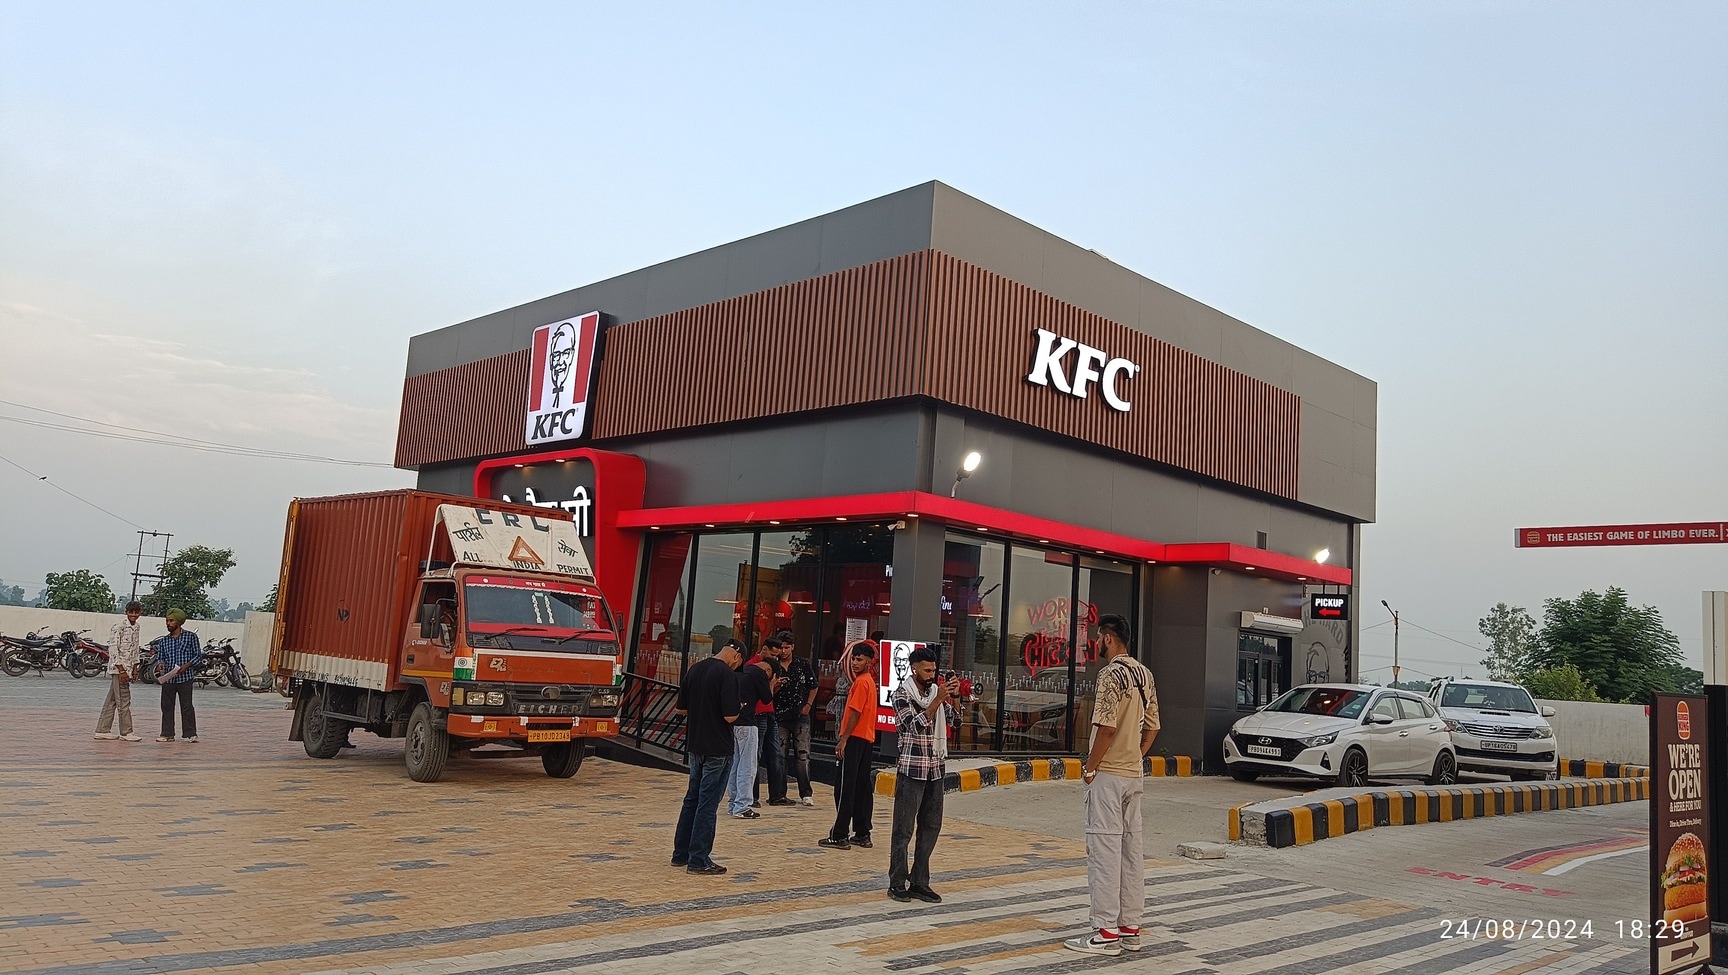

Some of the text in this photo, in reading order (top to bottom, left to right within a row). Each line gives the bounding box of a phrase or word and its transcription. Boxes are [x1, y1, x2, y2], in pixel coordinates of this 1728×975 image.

[1028, 327, 1135, 412] KFC
[531, 408, 576, 441] KFC
[1546, 533, 1564, 542] THE
[1567, 532, 1604, 541] EASIEST
[1606, 530, 1634, 540] GAME
[1637, 530, 1651, 539] OF
[1653, 529, 1685, 539] LIMBO
[1688, 528, 1719, 538] EVER.
[462, 550, 589, 576] ALL INDIA PERMIT
[1315, 598, 1344, 607] PICKUP
[877, 714, 887, 723] NO
[1667, 743, 1701, 769] WE'RE
[1668, 769, 1701, 800] OPEN
[1669, 801, 1674, 812] &
[1674, 801, 1686, 811] HERE
[1404, 867, 1577, 896] ENTRY
